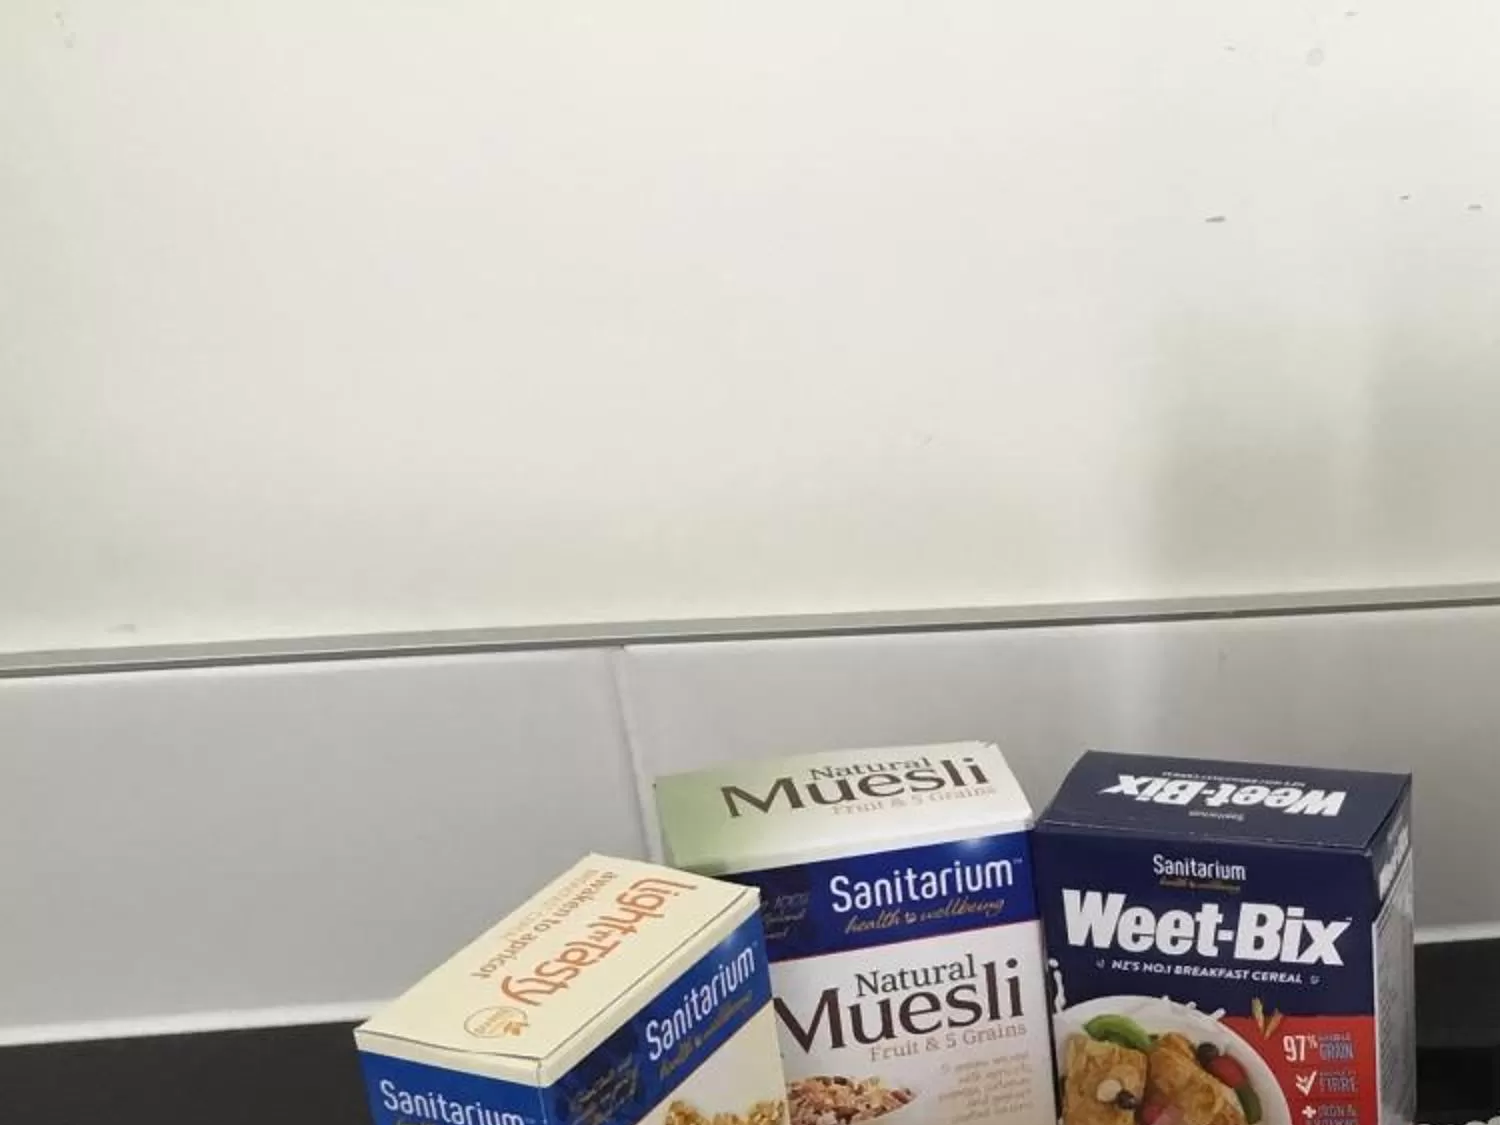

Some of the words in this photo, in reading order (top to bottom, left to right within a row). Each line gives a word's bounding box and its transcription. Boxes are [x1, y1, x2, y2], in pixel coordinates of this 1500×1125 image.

[722, 757, 990, 818] Muesli
[810, 756, 932, 782] Natural
[1100, 774, 1347, 817] Weet-Bix
[830, 858, 1013, 914] Sanitarium
[1153, 854, 1247, 882] Sanitarium
[1062, 888, 1348, 966] Weet-Bix
[855, 953, 978, 997] Natural
[1174, 965, 1250, 982] BREAKFAST
[1252, 970, 1303, 985] CEREAL
[646, 946, 756, 1060] Sanitarium
[773, 958, 1024, 1054] Muesli
[871, 1037, 919, 1062] Fruit
[962, 1023, 1028, 1047] Grains
